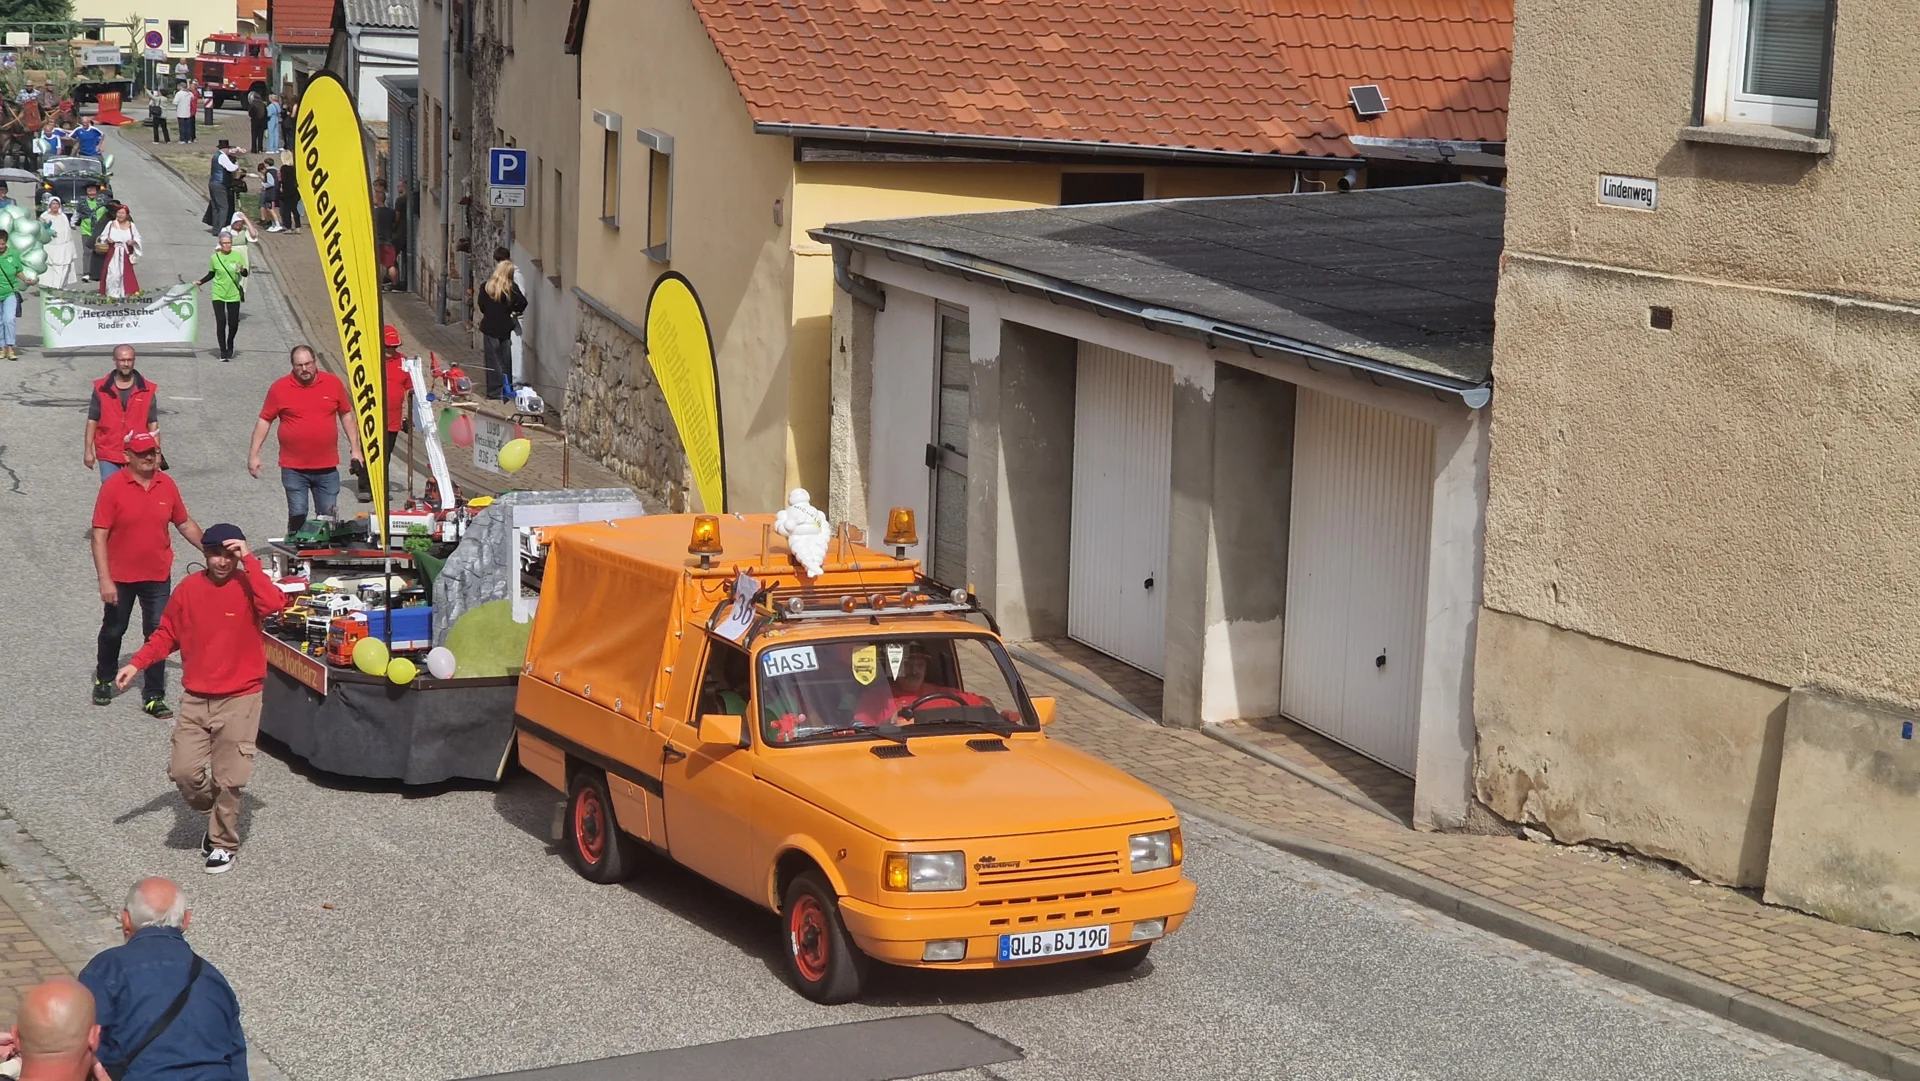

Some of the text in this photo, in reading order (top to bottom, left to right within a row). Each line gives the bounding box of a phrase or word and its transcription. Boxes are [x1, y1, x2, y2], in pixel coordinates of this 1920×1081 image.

[499, 154, 518, 180] P
[1603, 178, 1653, 207] Lindenweg
[297, 108, 380, 465] Modelltrucktreffen
[97, 320, 141, 330] Rieder e.V.
[732, 593, 753, 625] 36
[285, 647, 318, 688] Vorharz
[765, 652, 816, 675] HASI
[1011, 935, 1042, 956] QLB
[1054, 932, 1075, 952] BJ
[1078, 928, 1107, 949] 190
